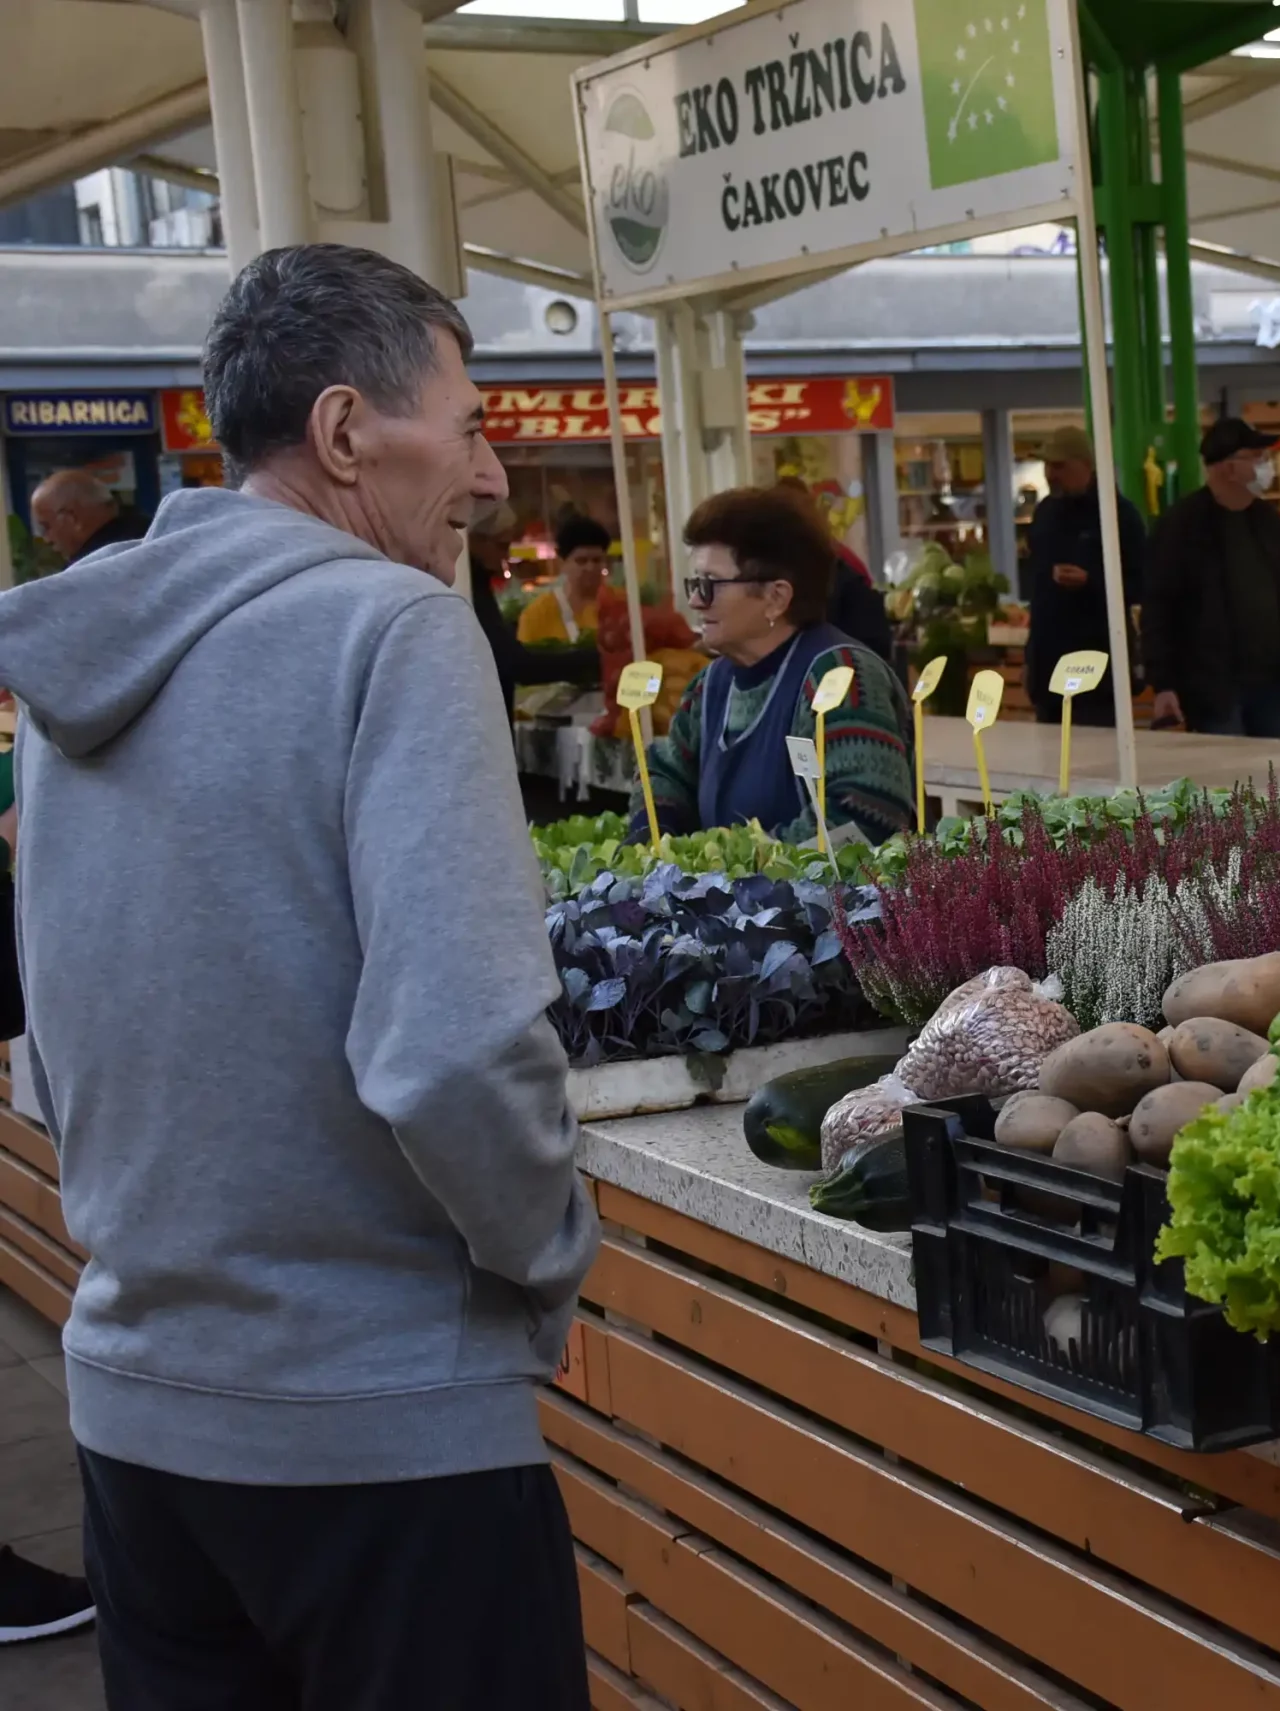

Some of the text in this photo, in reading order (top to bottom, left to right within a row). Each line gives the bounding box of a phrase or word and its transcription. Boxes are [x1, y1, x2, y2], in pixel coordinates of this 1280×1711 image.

[674, 22, 907, 159] EKO TRŽNICA
[609, 143, 657, 217] eko
[720, 151, 870, 232] ČAKOVEC
[10, 400, 149, 426] RIBARNICA
